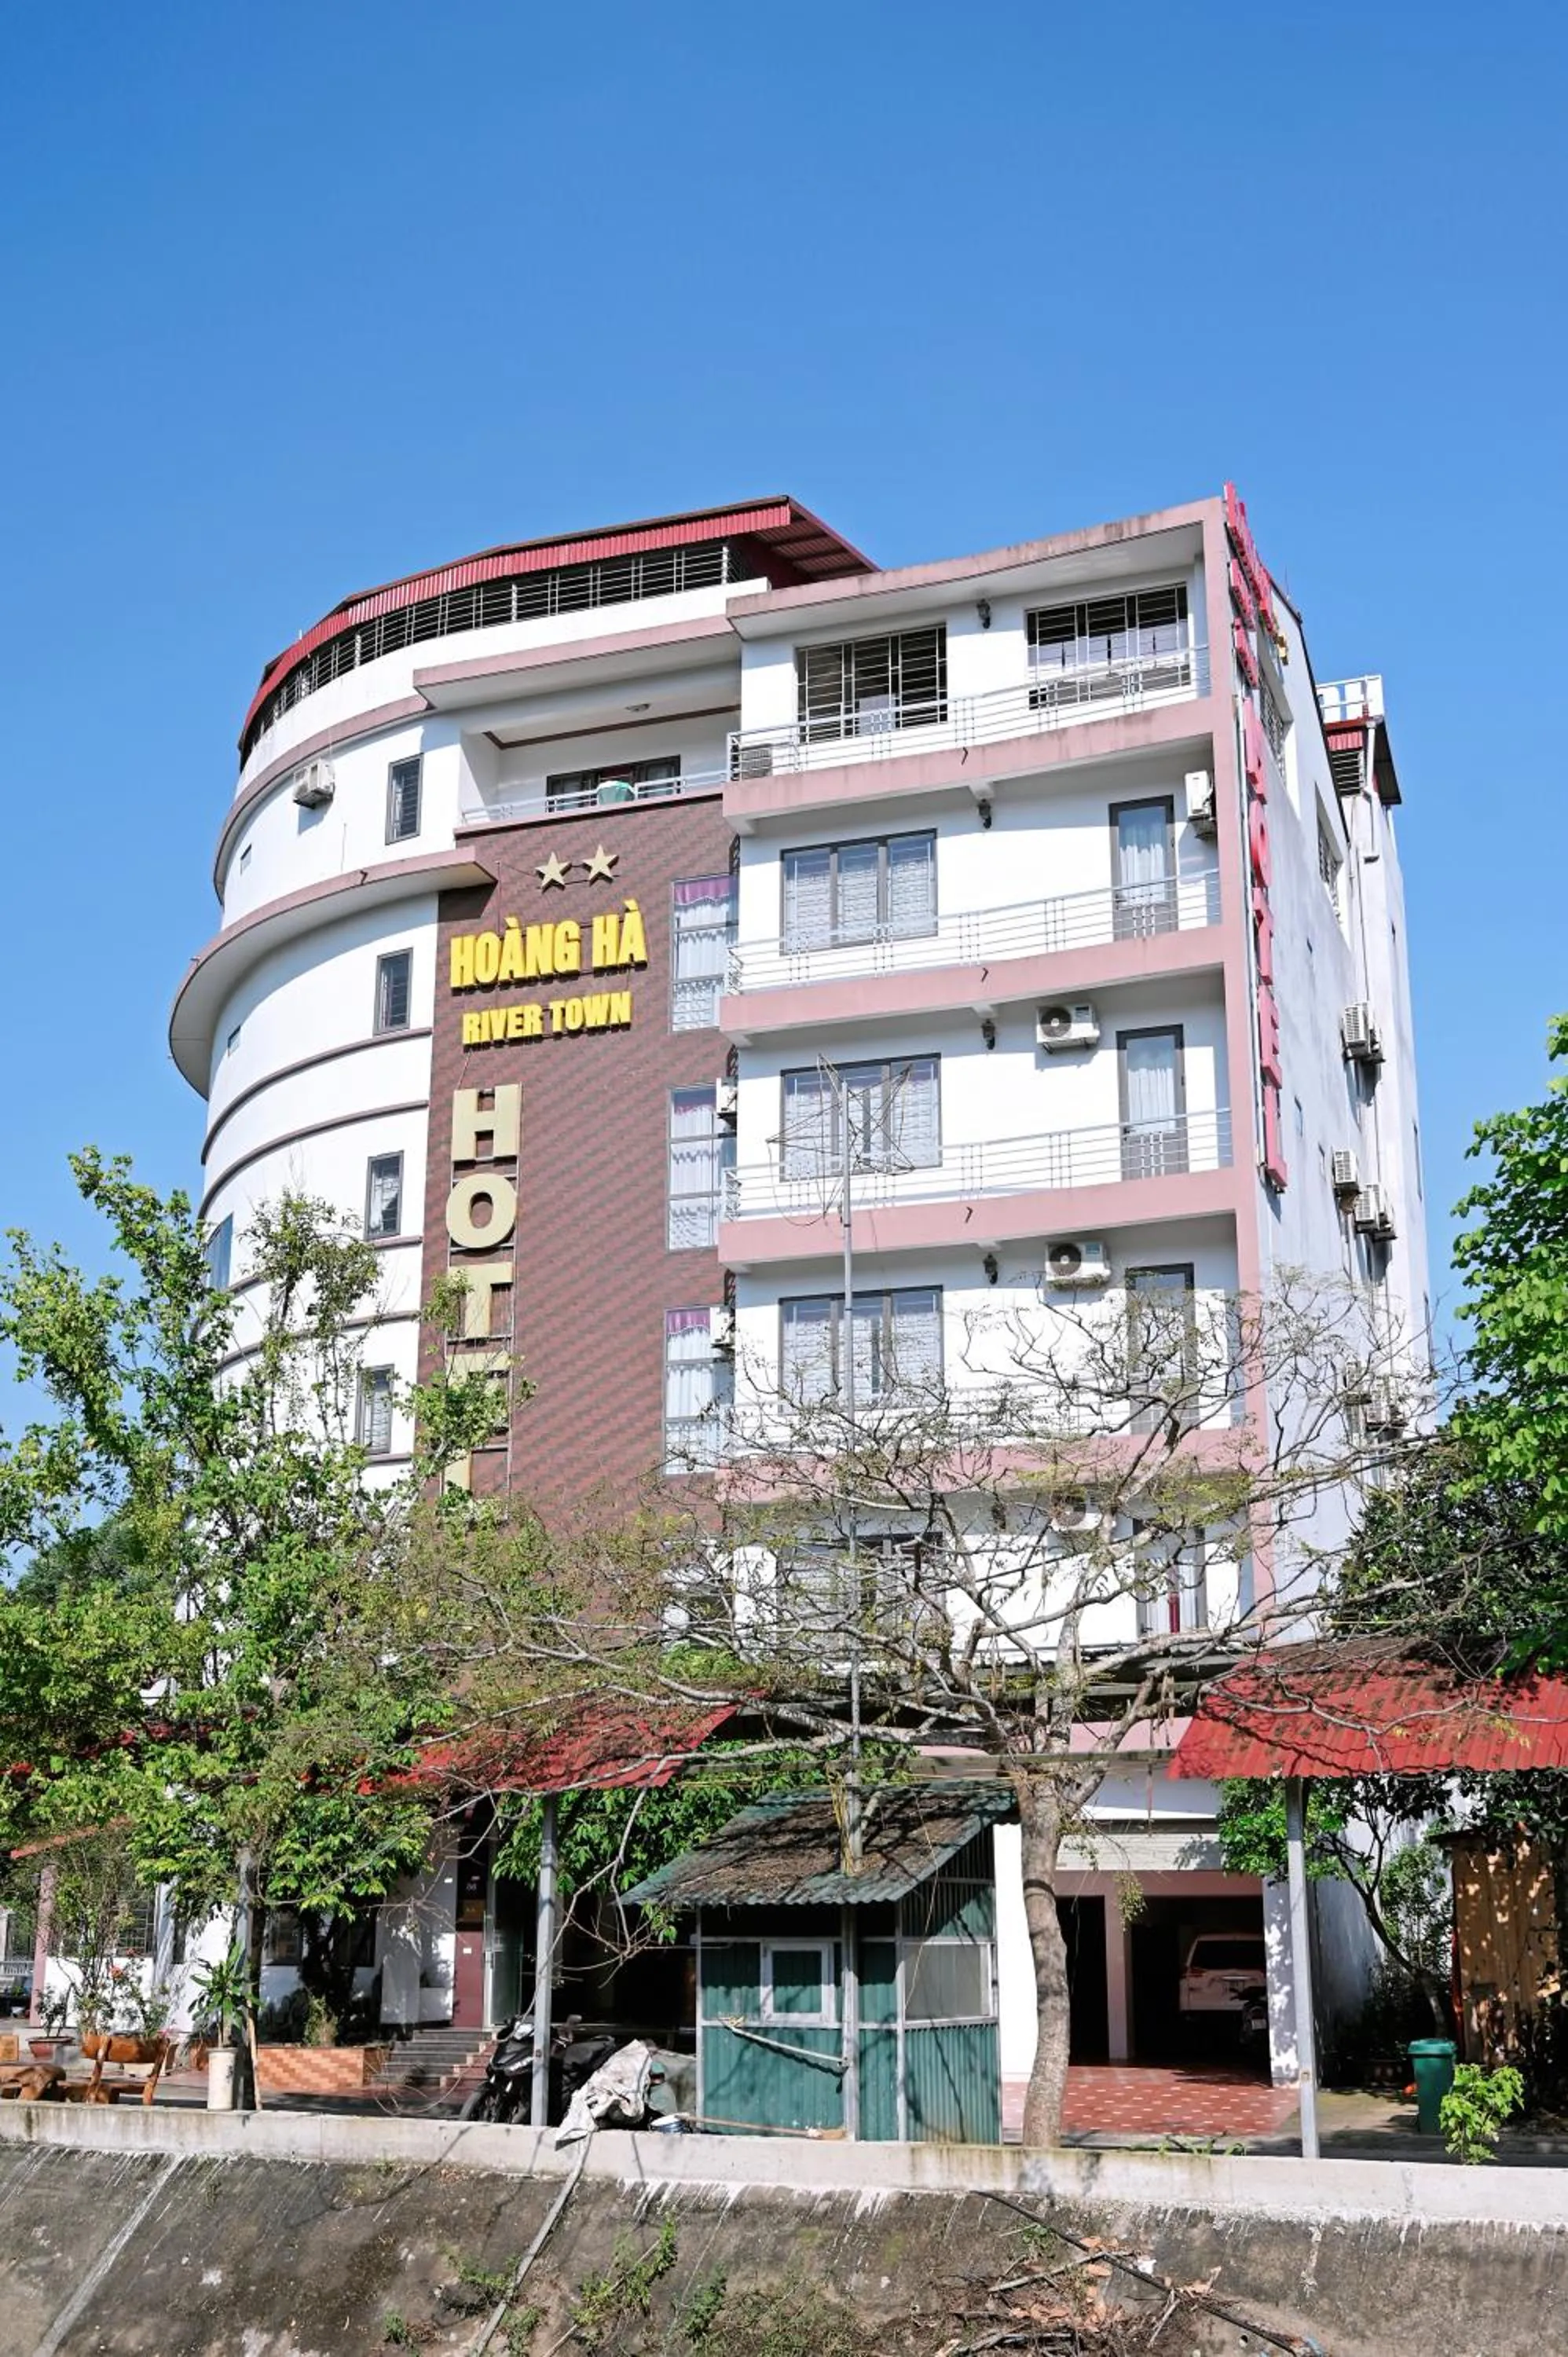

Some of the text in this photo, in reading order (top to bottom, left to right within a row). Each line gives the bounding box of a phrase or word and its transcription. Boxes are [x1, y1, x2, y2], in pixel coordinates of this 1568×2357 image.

[450, 899, 647, 988] HOÀNG HÀ
[463, 991, 631, 1045] RIVER TOWN
